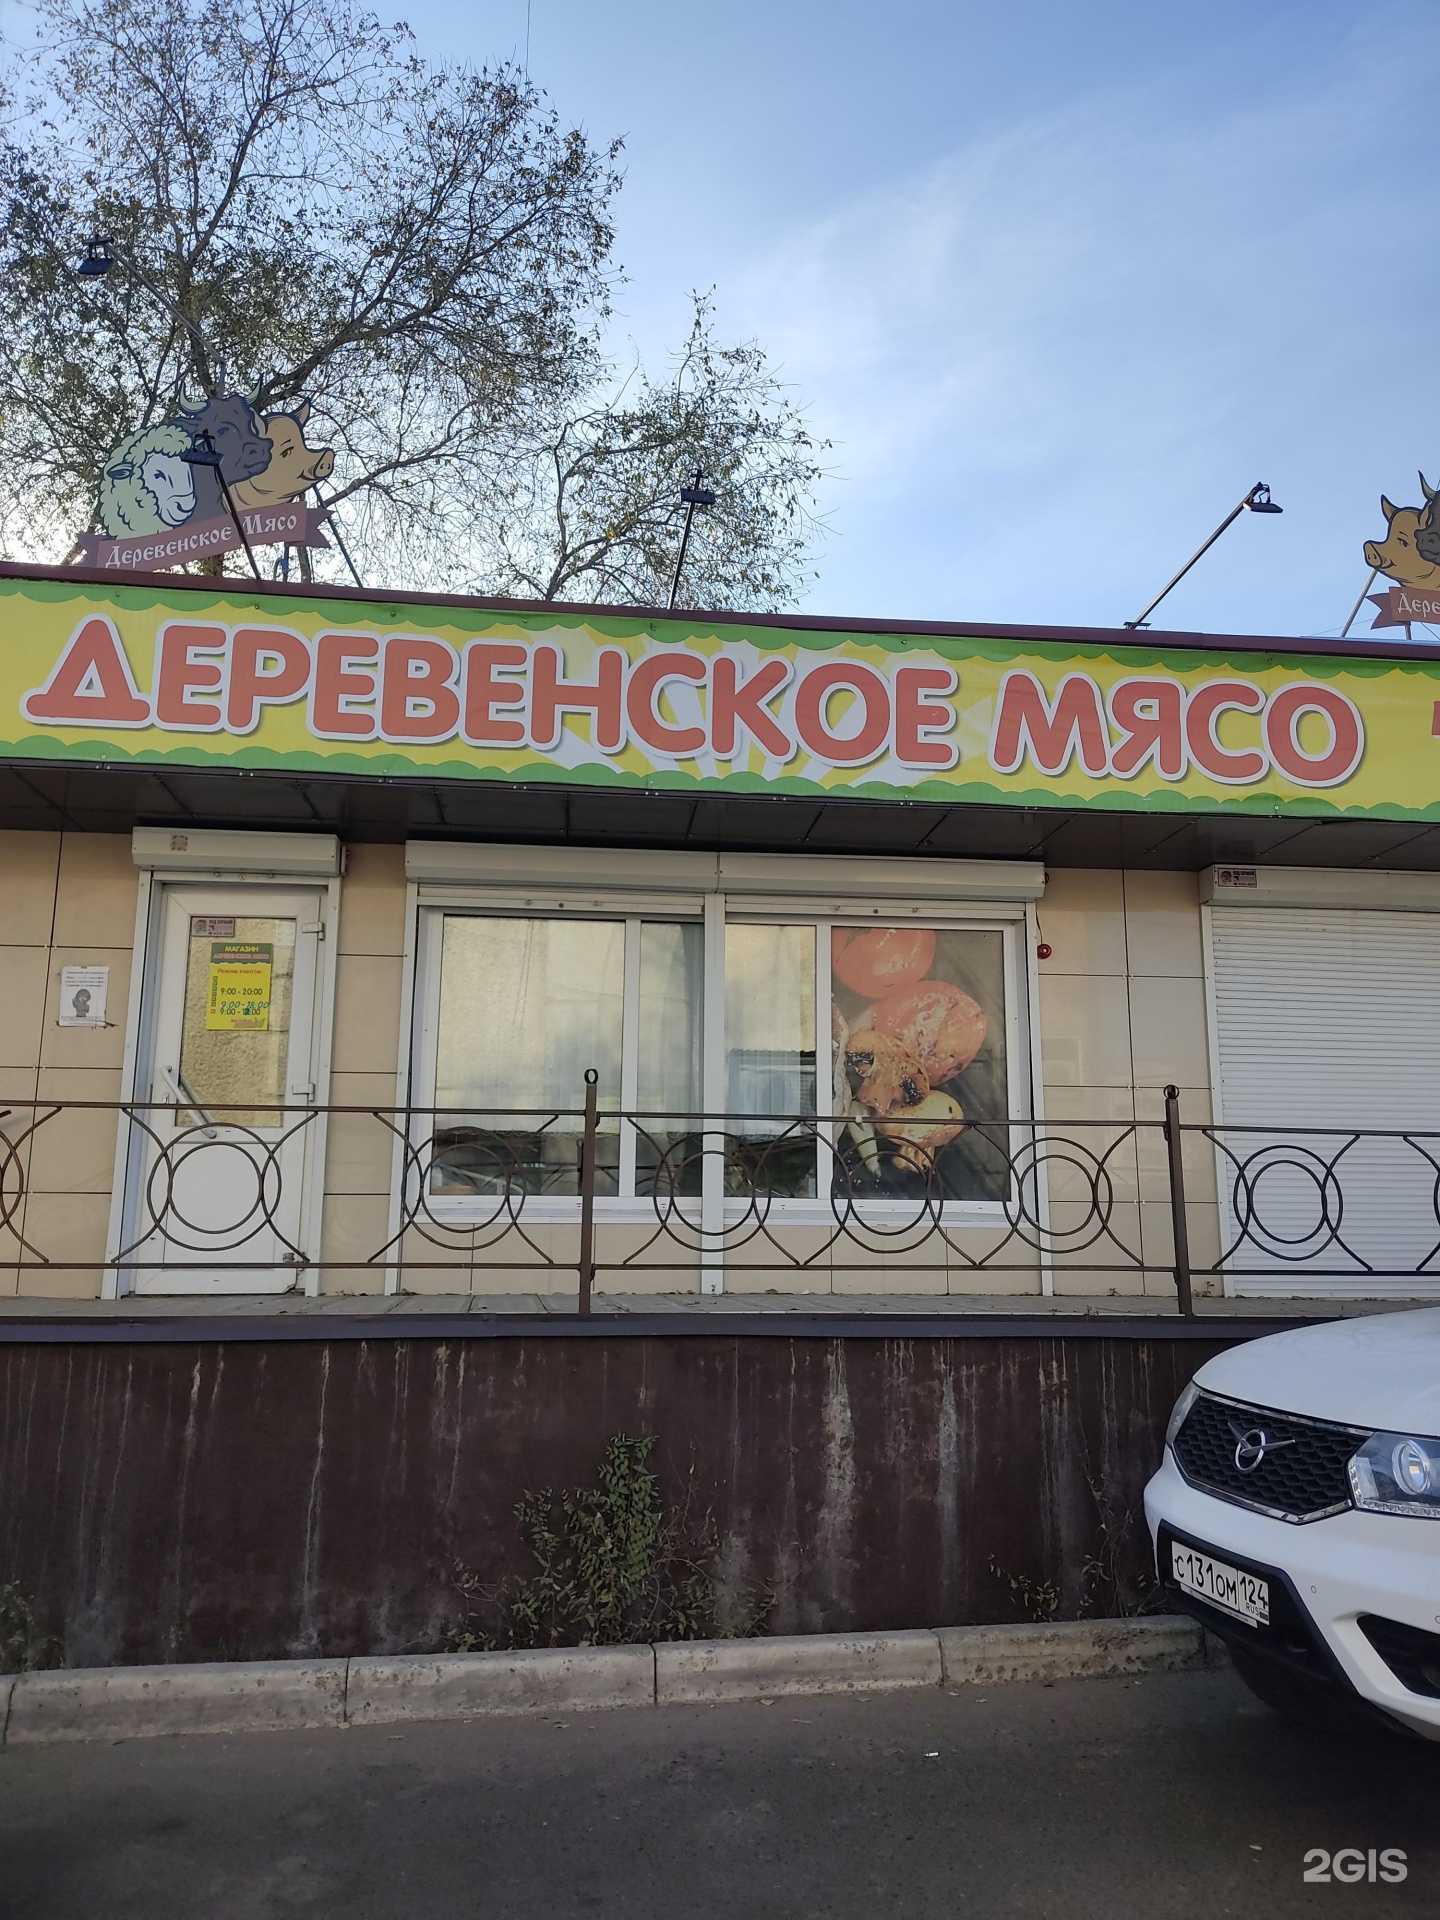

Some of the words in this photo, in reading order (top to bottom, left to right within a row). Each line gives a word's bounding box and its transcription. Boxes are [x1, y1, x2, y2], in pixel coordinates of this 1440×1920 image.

[105, 526, 233, 569] Деревенское
[242, 513, 297, 536] Мясо
[23, 616, 956, 767] ДЕРЕВЕНСКОЕ
[990, 671, 1362, 785] МЯСО
[1240, 1576, 1269, 1609] 124
